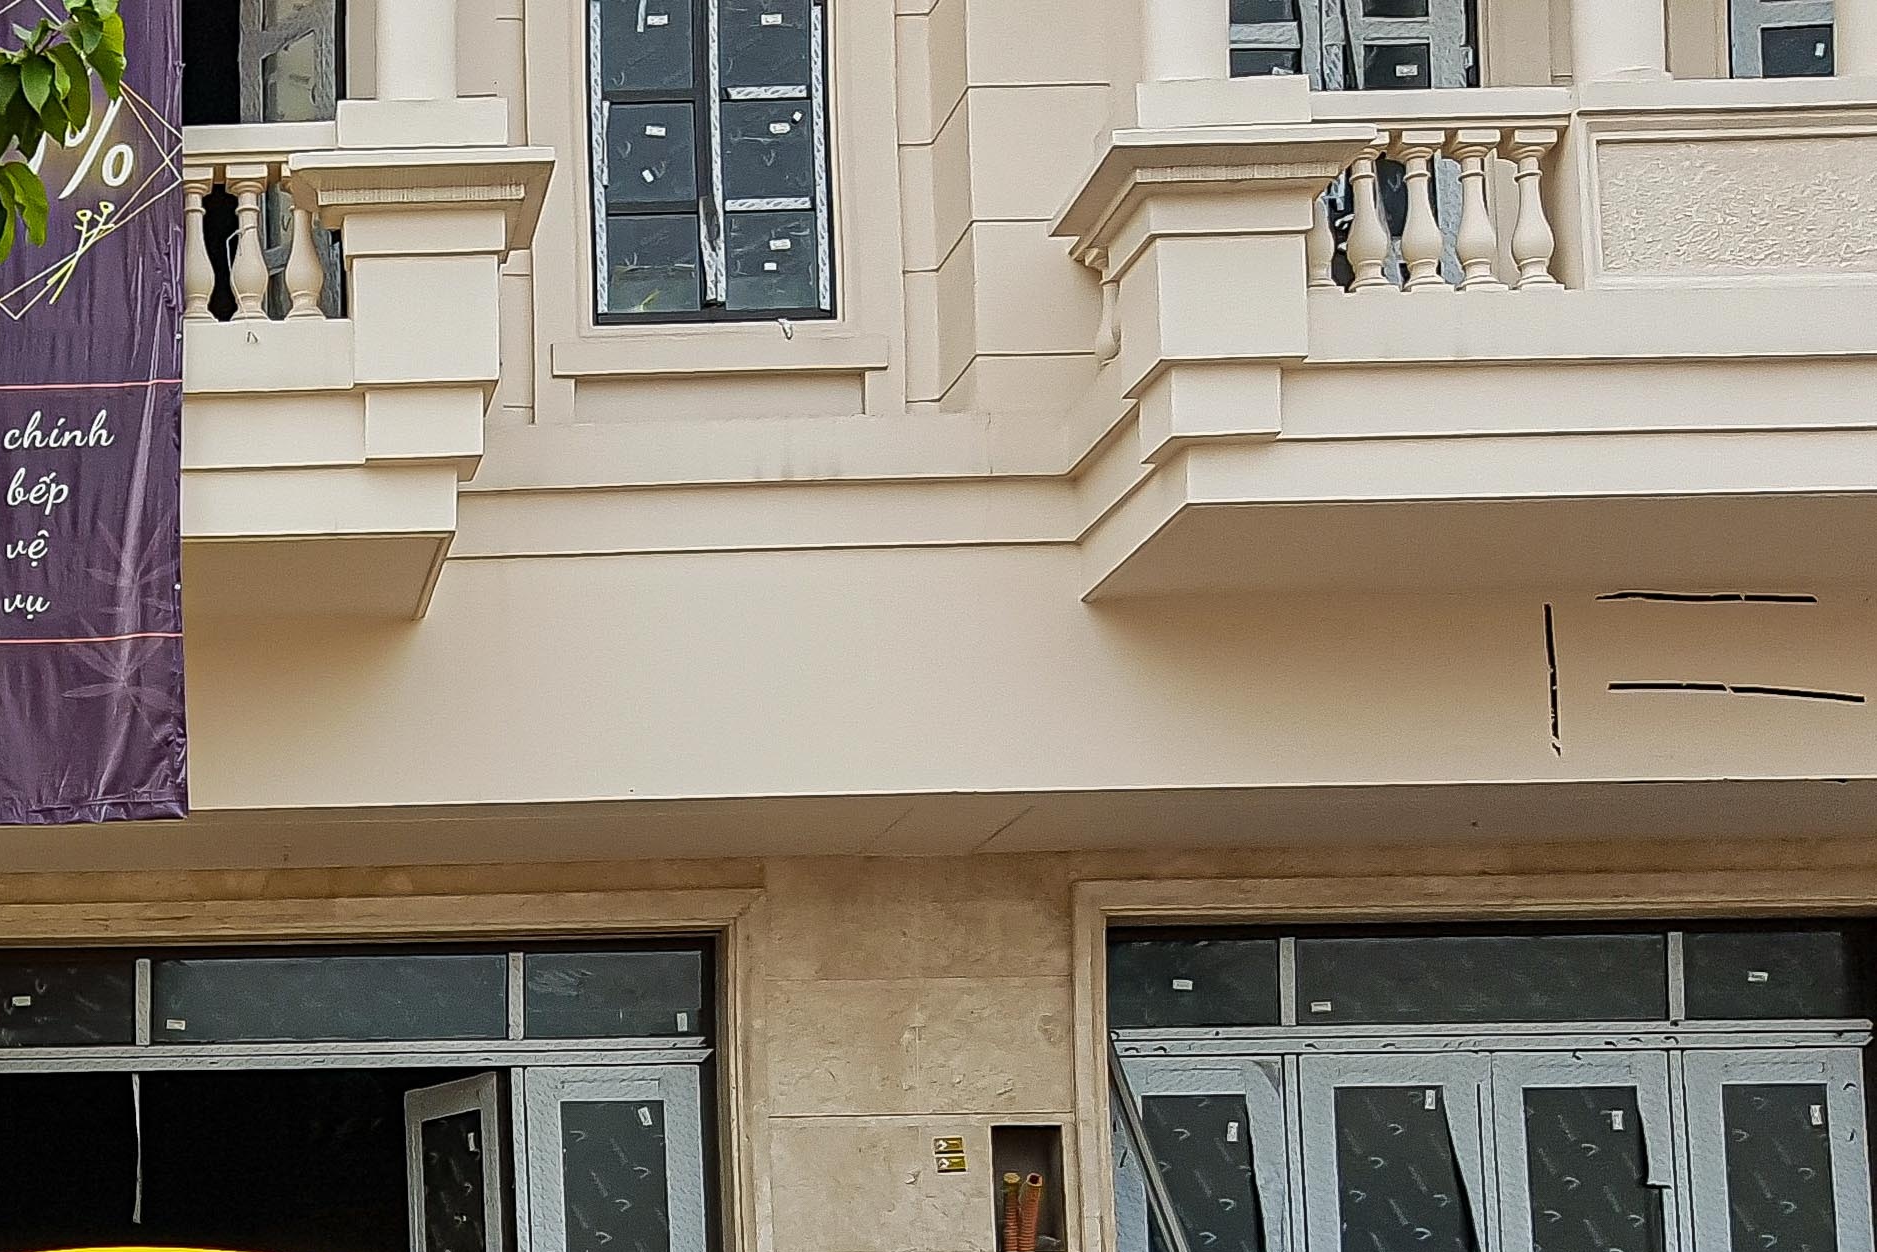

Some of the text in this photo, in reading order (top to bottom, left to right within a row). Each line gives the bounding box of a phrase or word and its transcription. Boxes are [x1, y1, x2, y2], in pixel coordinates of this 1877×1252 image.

[4, 409, 115, 450] chính
[7, 467, 69, 516] bếp
[6, 529, 50, 567] vệ
[4, 594, 51, 620] vụ
